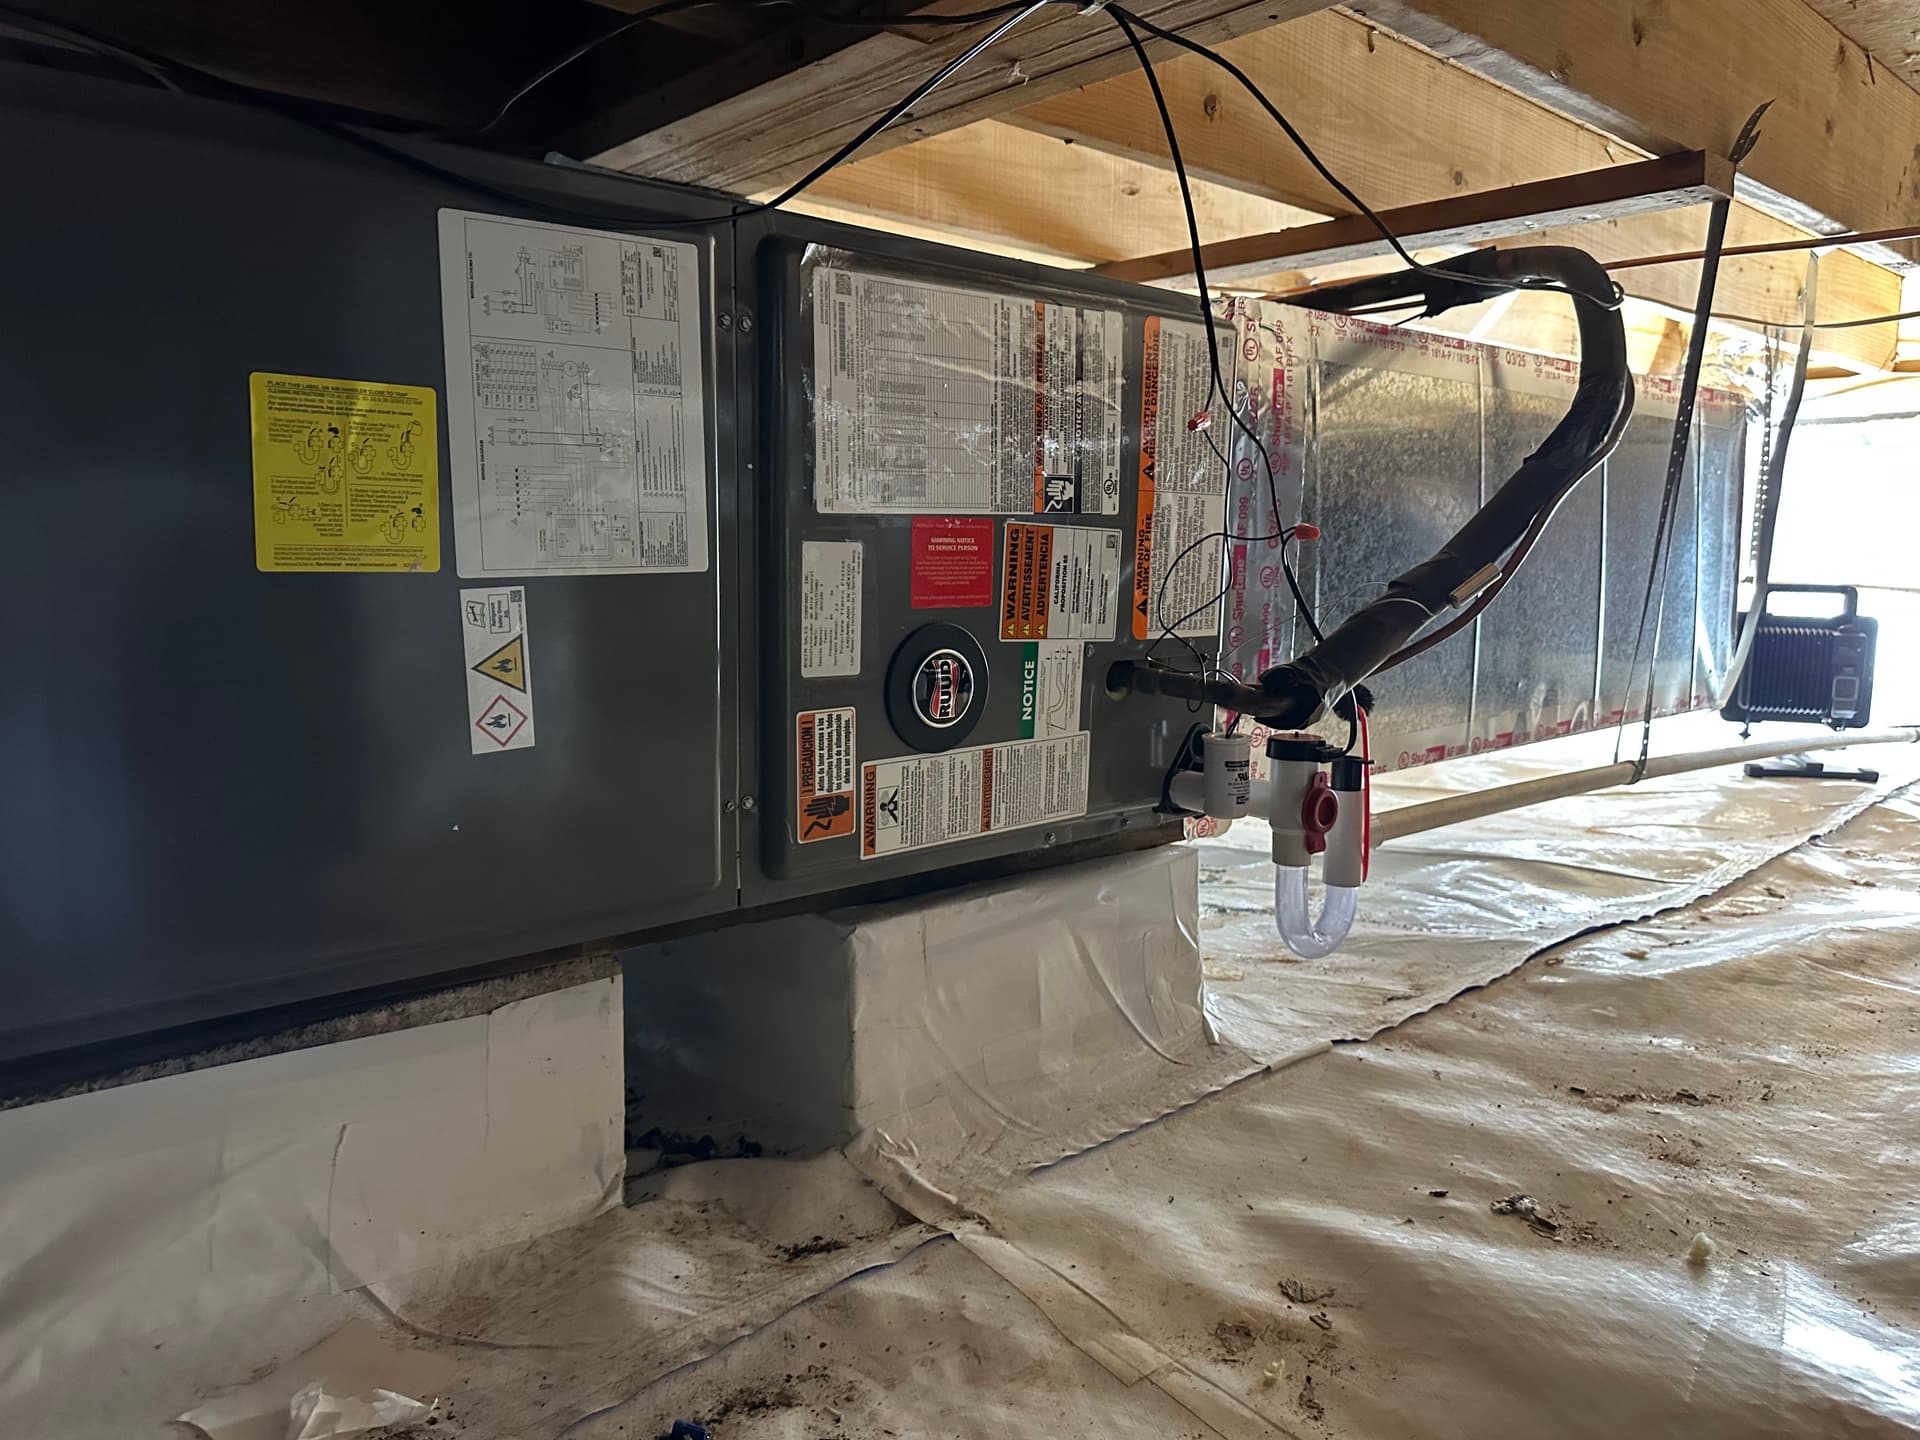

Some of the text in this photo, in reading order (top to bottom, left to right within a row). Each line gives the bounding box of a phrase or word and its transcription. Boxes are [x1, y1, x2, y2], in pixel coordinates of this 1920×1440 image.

[1150, 330, 1159, 406] D'INCENDIE
[1274, 347, 1284, 366] AF
[1505, 350, 1526, 368] 03/25
[1144, 513, 1152, 541] FIRE
[1239, 496, 1249, 520] 099
[1006, 528, 1020, 620] WARNING
[1021, 528, 1034, 621] AVERTISSEMENT
[1036, 534, 1049, 616] ADVERTENCIA
[1053, 561, 1061, 605] CALIFORNIA
[1060, 565, 1068, 613] PROPOSITION
[1135, 528, 1145, 592] WARNING
[1142, 566, 1150, 596] RISK
[940, 660, 952, 718] RUUD
[1022, 660, 1035, 721] NOTICE
[865, 771, 875, 837] WARNING
[983, 748, 993, 819] AVERTISSEMENT
